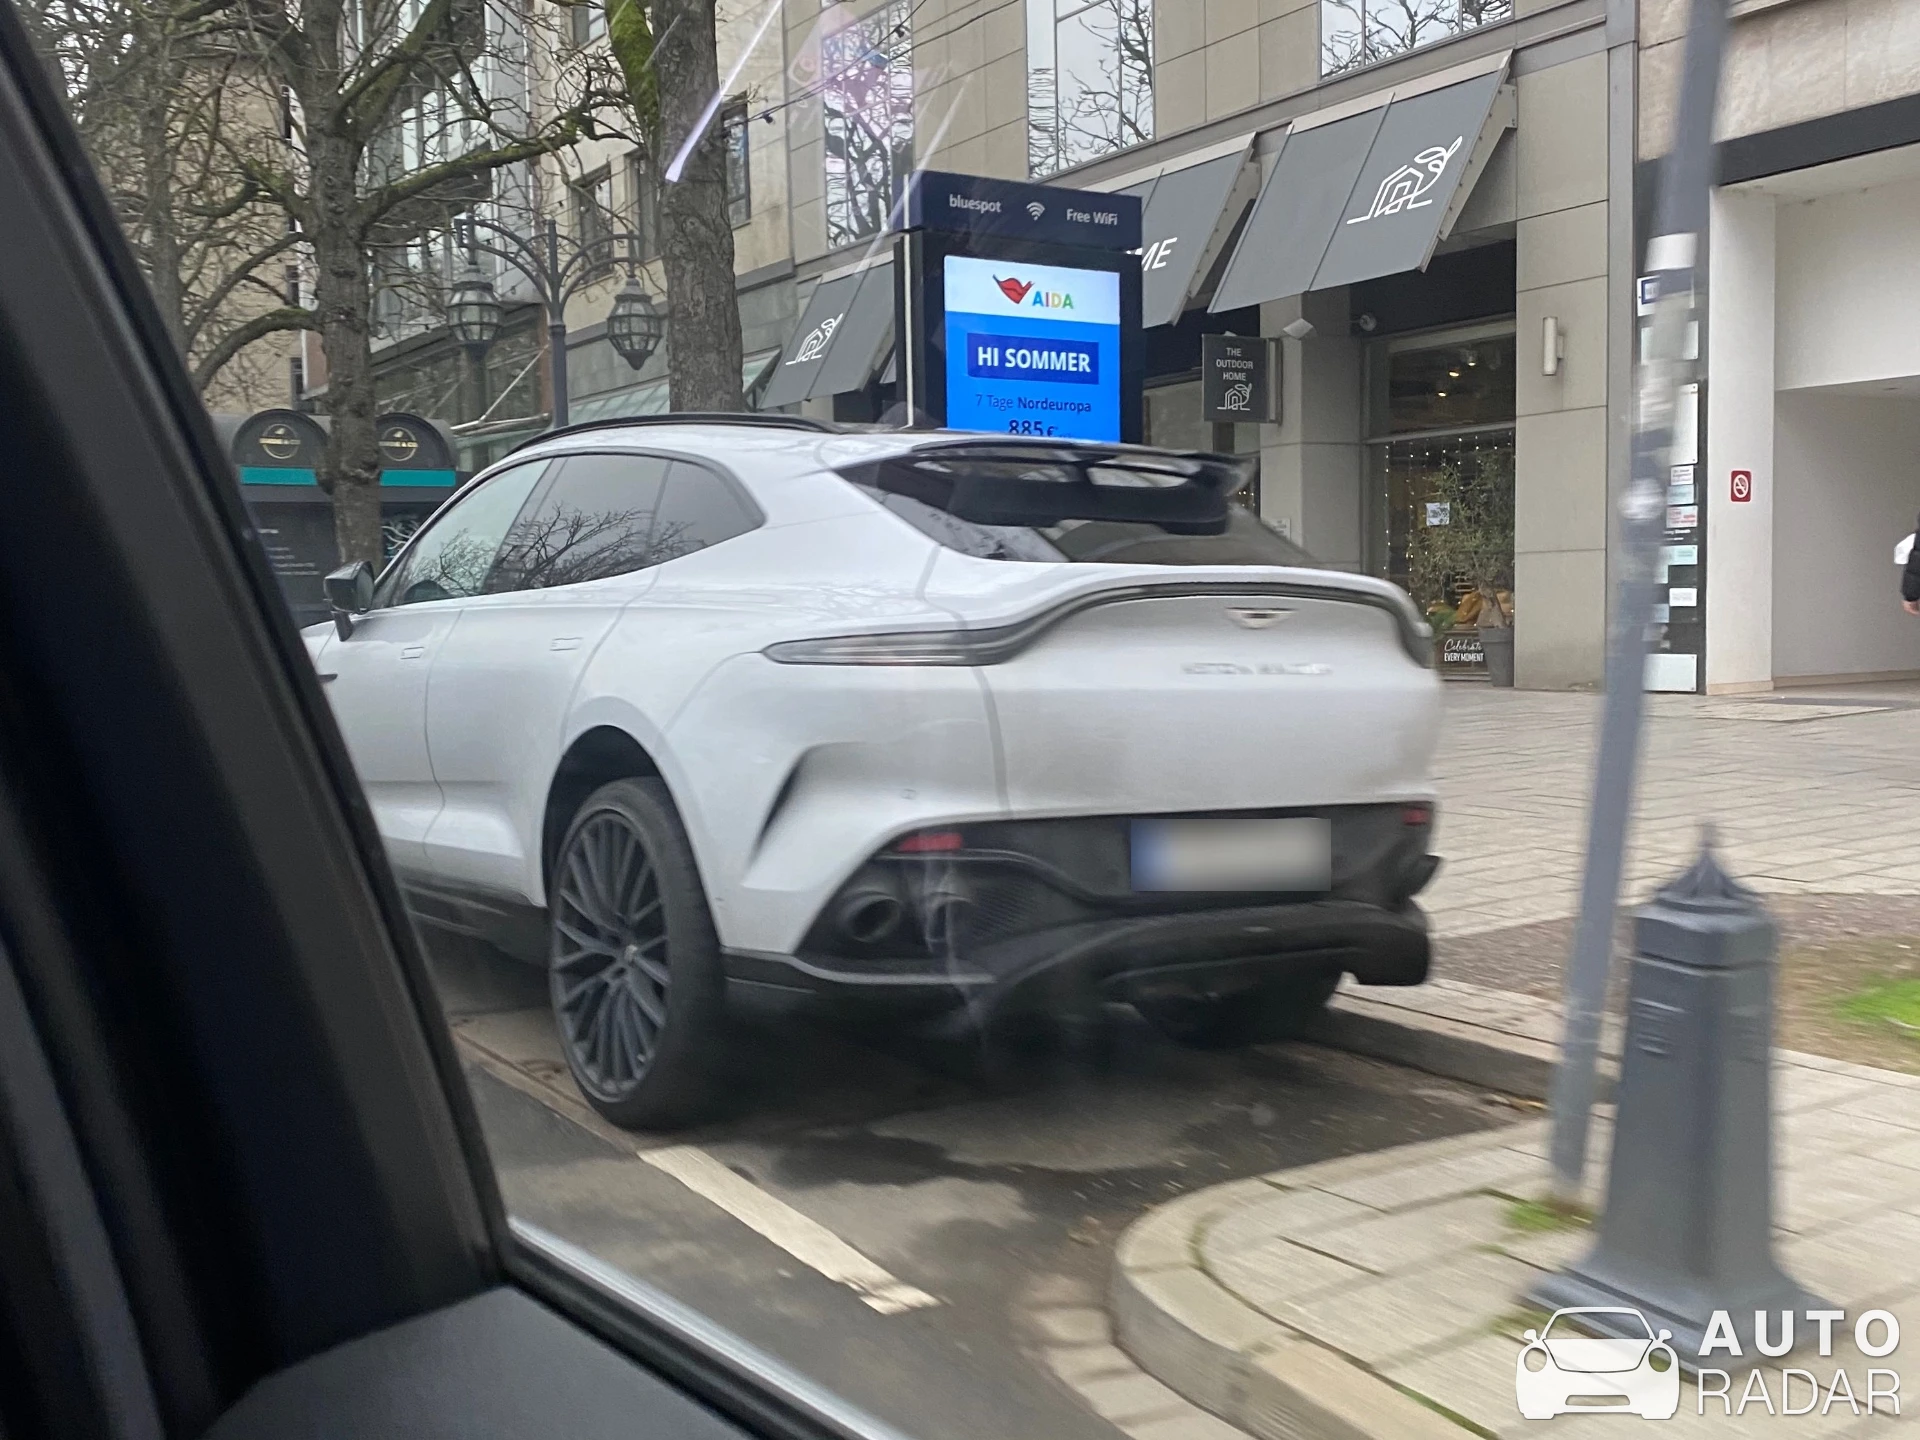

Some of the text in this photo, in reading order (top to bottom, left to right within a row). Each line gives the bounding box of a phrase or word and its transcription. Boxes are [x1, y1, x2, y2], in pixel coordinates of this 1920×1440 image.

[950, 194, 1002, 212] bluespot
[1067, 209, 1118, 225] Free WiFi
[1126, 237, 1178, 271] ME
[1032, 291, 1074, 309] AIDA
[977, 346, 1091, 373] HI SOMMER
[1226, 347, 1242, 356] THE
[1216, 359, 1253, 369] OUTDOOR
[1223, 372, 1246, 380] HOME
[976, 394, 1091, 415] 7 Tage Nordeuropa
[1444, 639, 1483, 652] Celebrate
[1444, 653, 1484, 662] EVERY MOMENT
